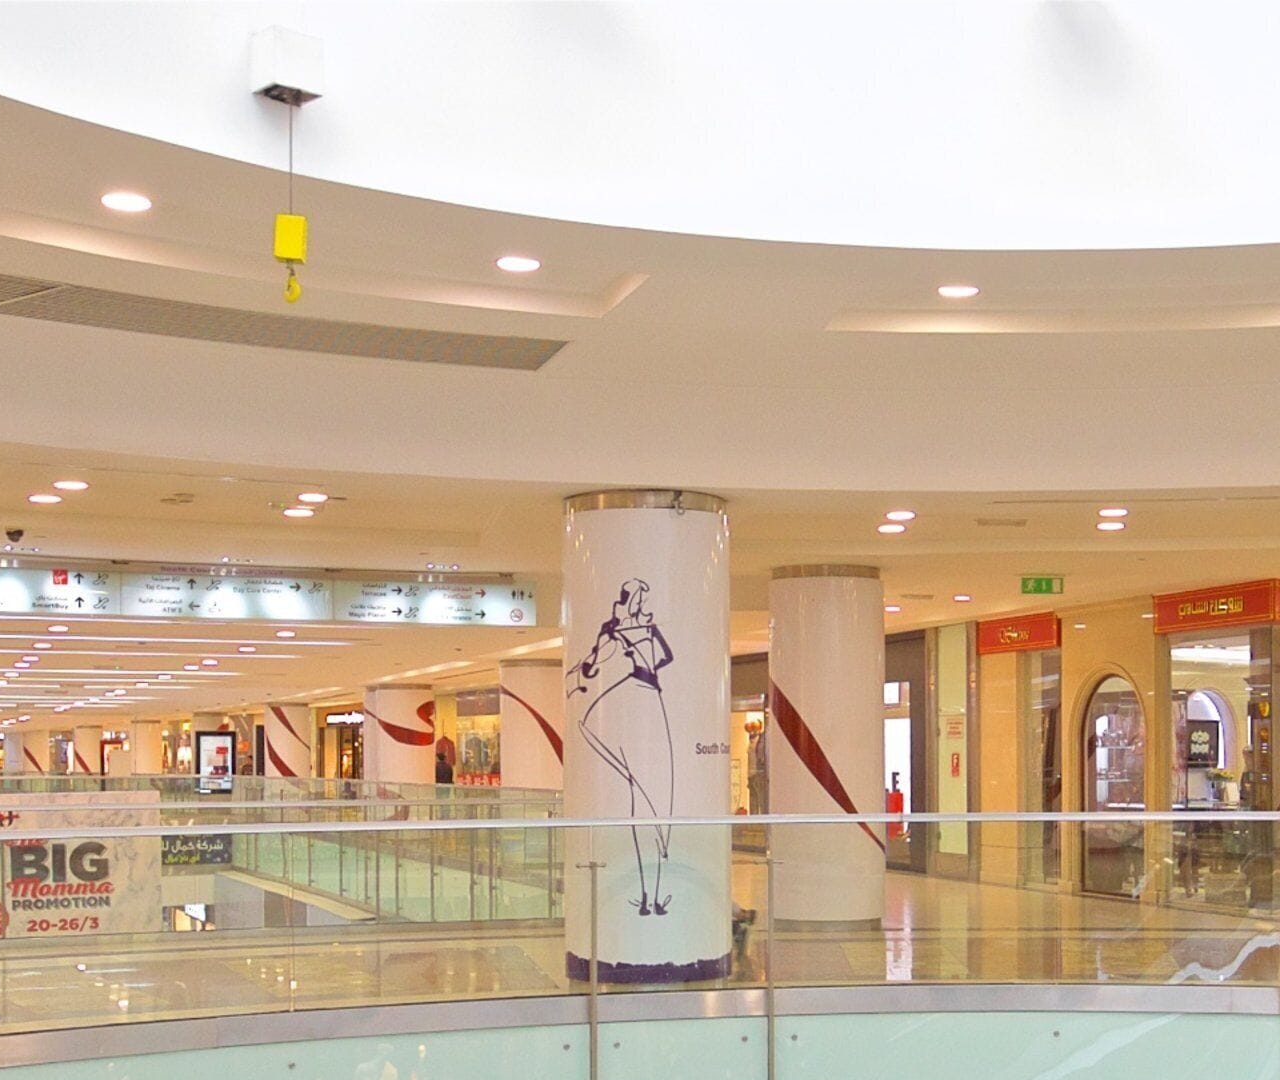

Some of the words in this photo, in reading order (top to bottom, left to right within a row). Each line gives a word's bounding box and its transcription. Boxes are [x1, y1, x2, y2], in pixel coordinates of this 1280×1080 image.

[10, 842, 109, 884] BIG
[6, 877, 115, 898] Momma
[11, 896, 111, 911] PROMOTION
[26, 916, 100, 932] 20-26/3
